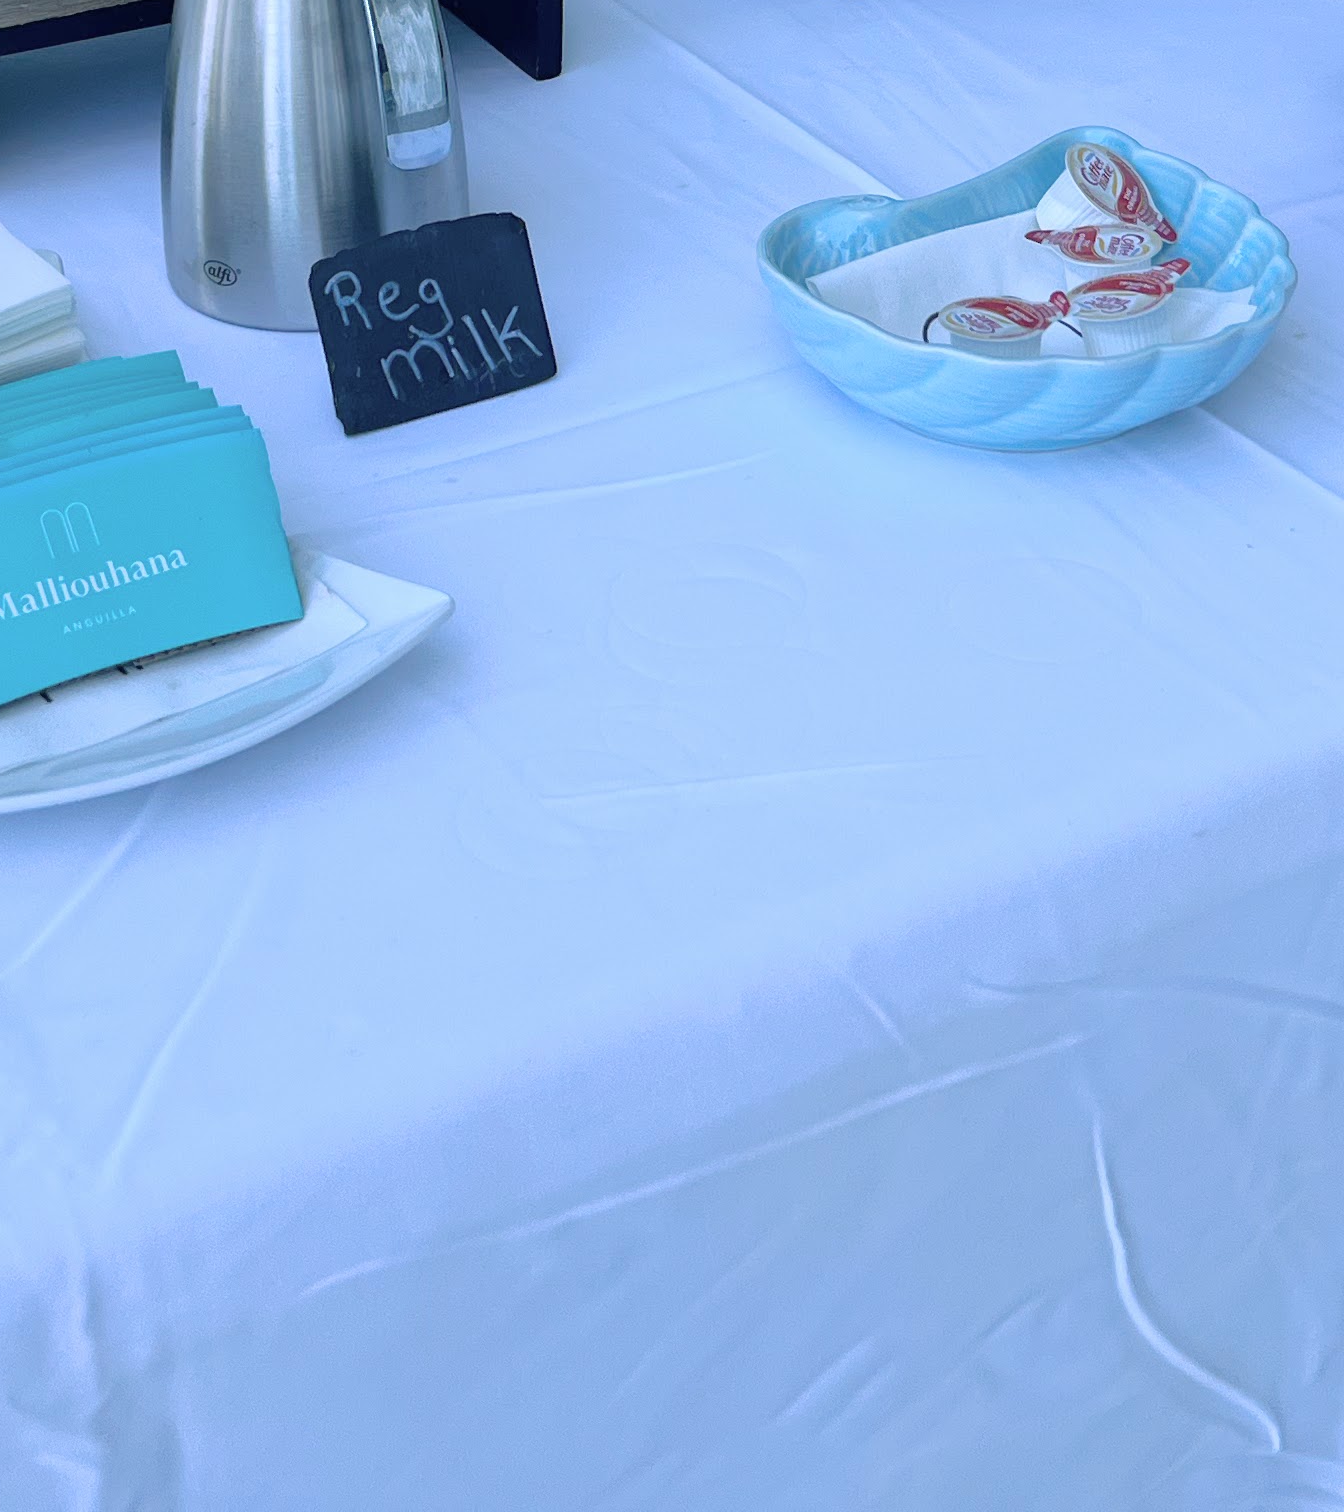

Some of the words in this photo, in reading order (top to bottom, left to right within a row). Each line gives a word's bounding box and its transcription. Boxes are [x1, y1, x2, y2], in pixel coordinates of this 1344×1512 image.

[208, 266, 232, 286] alfi
[323, 270, 455, 340] Reg
[380, 305, 544, 401] milk
[62, 605, 137, 636] ANGUILLA
